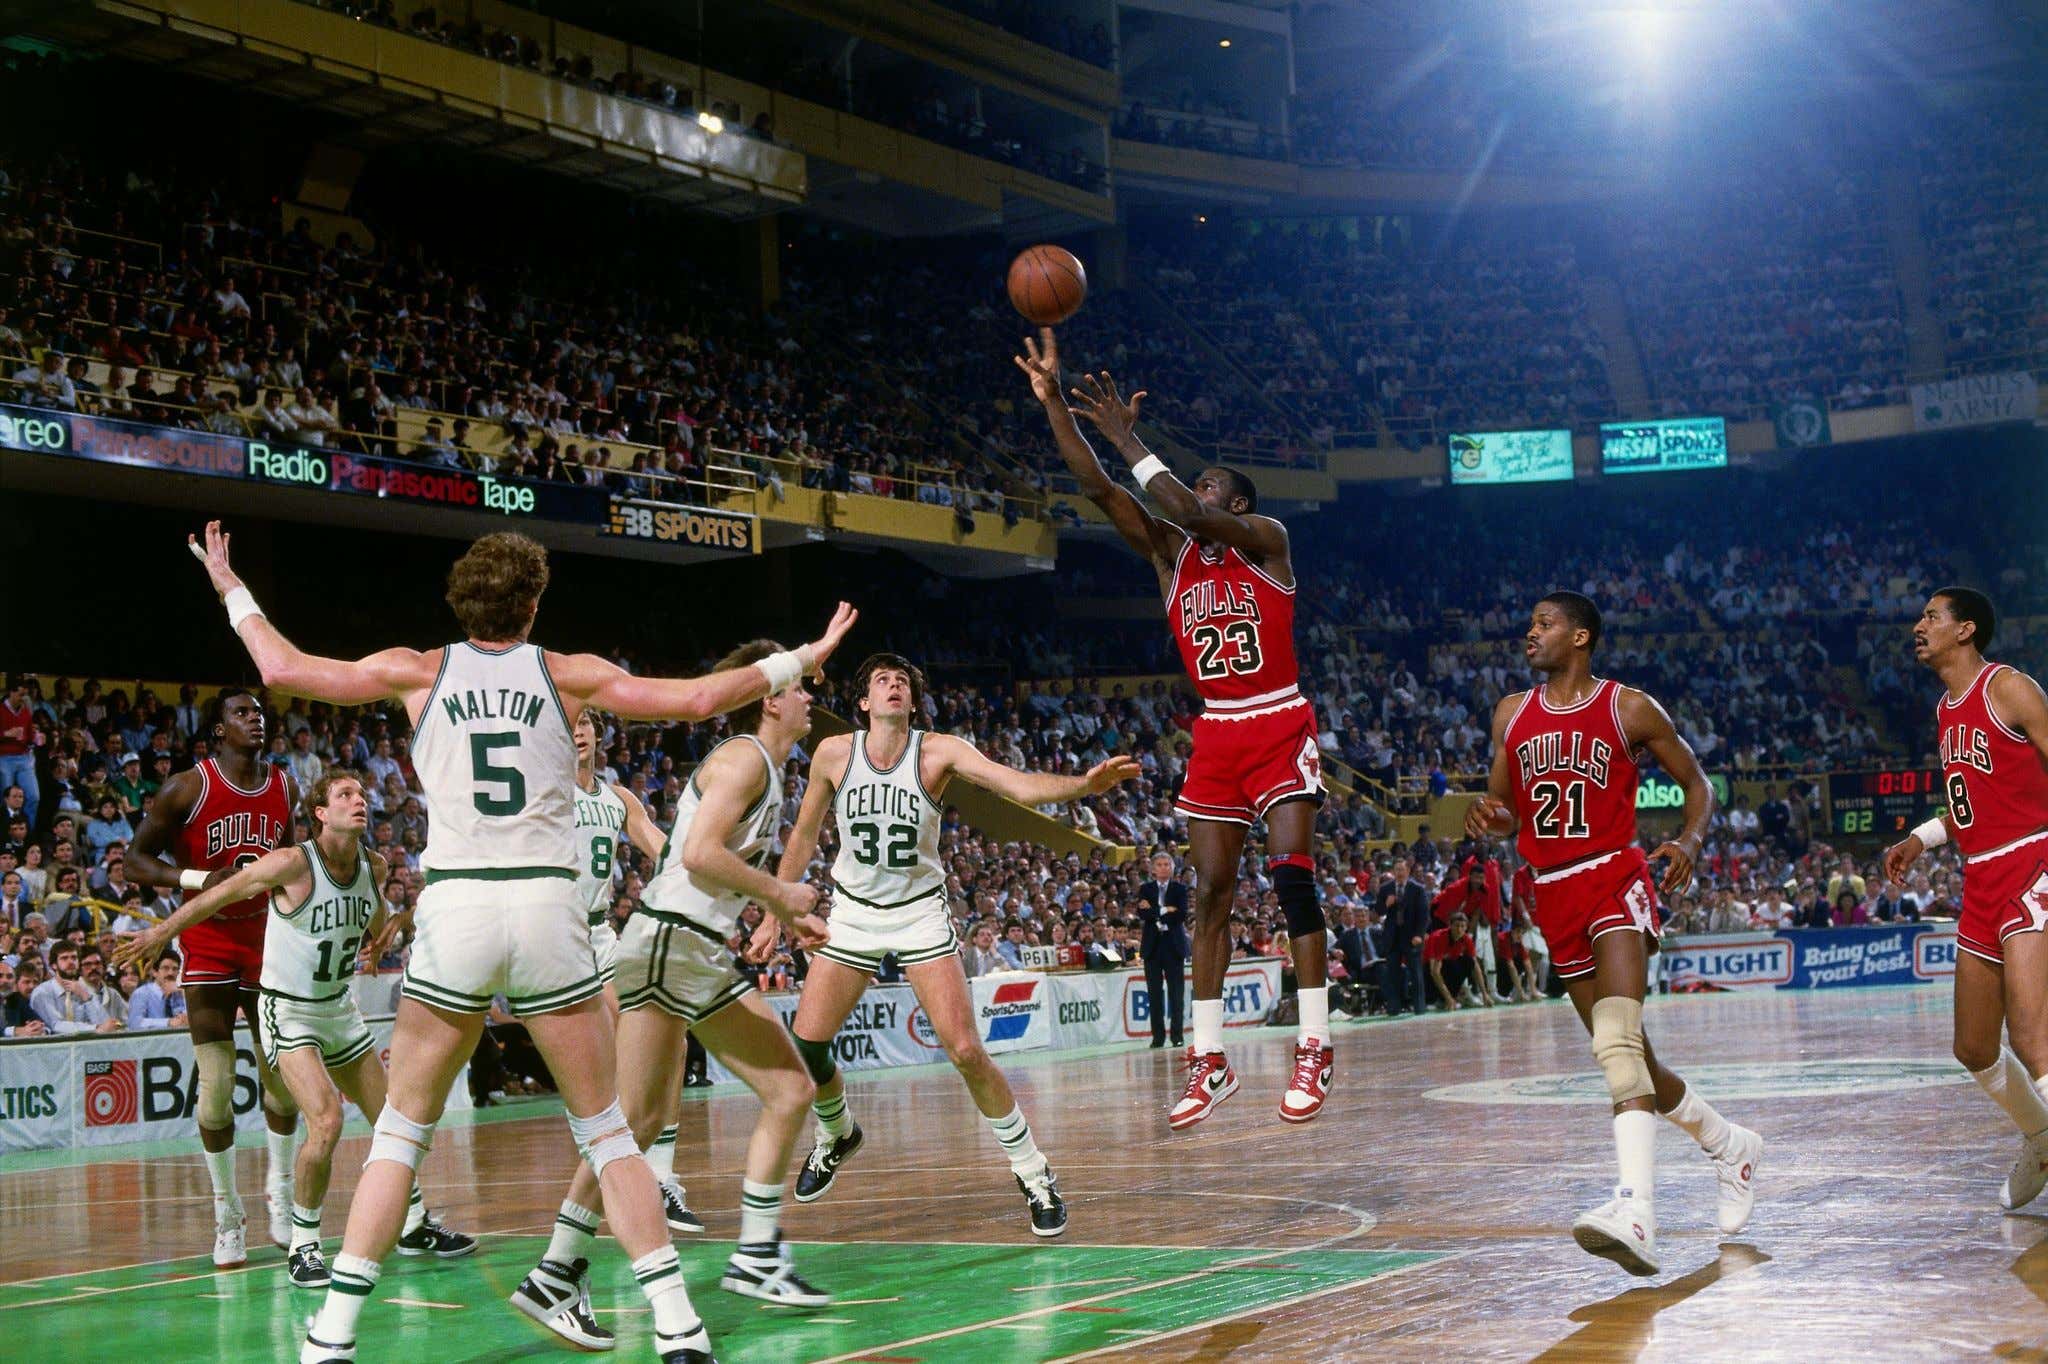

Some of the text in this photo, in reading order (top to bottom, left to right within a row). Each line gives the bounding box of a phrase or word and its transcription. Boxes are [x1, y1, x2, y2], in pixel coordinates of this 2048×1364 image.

[72, 417, 244, 473] Panasonic
[249, 442, 326, 484] Radio
[331, 454, 477, 505] Panasonic
[477, 475, 535, 515] Tape
[620, 506, 748, 548] 38 SPORTS
[1180, 579, 1261, 637] BULLS
[1192, 620, 1264, 680] 23
[442, 688, 546, 728] WALTON
[1516, 731, 1612, 790] BULLS
[1940, 724, 1994, 774] ULLS
[470, 731, 526, 816] 5
[1634, 777, 1685, 808] olso
[846, 783, 920, 826] CELTICS
[1531, 781, 1589, 839] 21
[591, 835, 612, 879] 8
[850, 822, 918, 867] 32
[312, 936, 361, 982] 12
[1698, 950, 1783, 976] LIGHT
[1803, 934, 1903, 967] Bring out
[1808, 963, 1861, 988] your
[981, 1001, 1042, 1018] SportsChannel
[1059, 1000, 1101, 1025] CELTICS
[87, 1063, 112, 1075] BASF
[831, 1034, 880, 1063] YOTA
[0, 1083, 58, 1119] TICS
